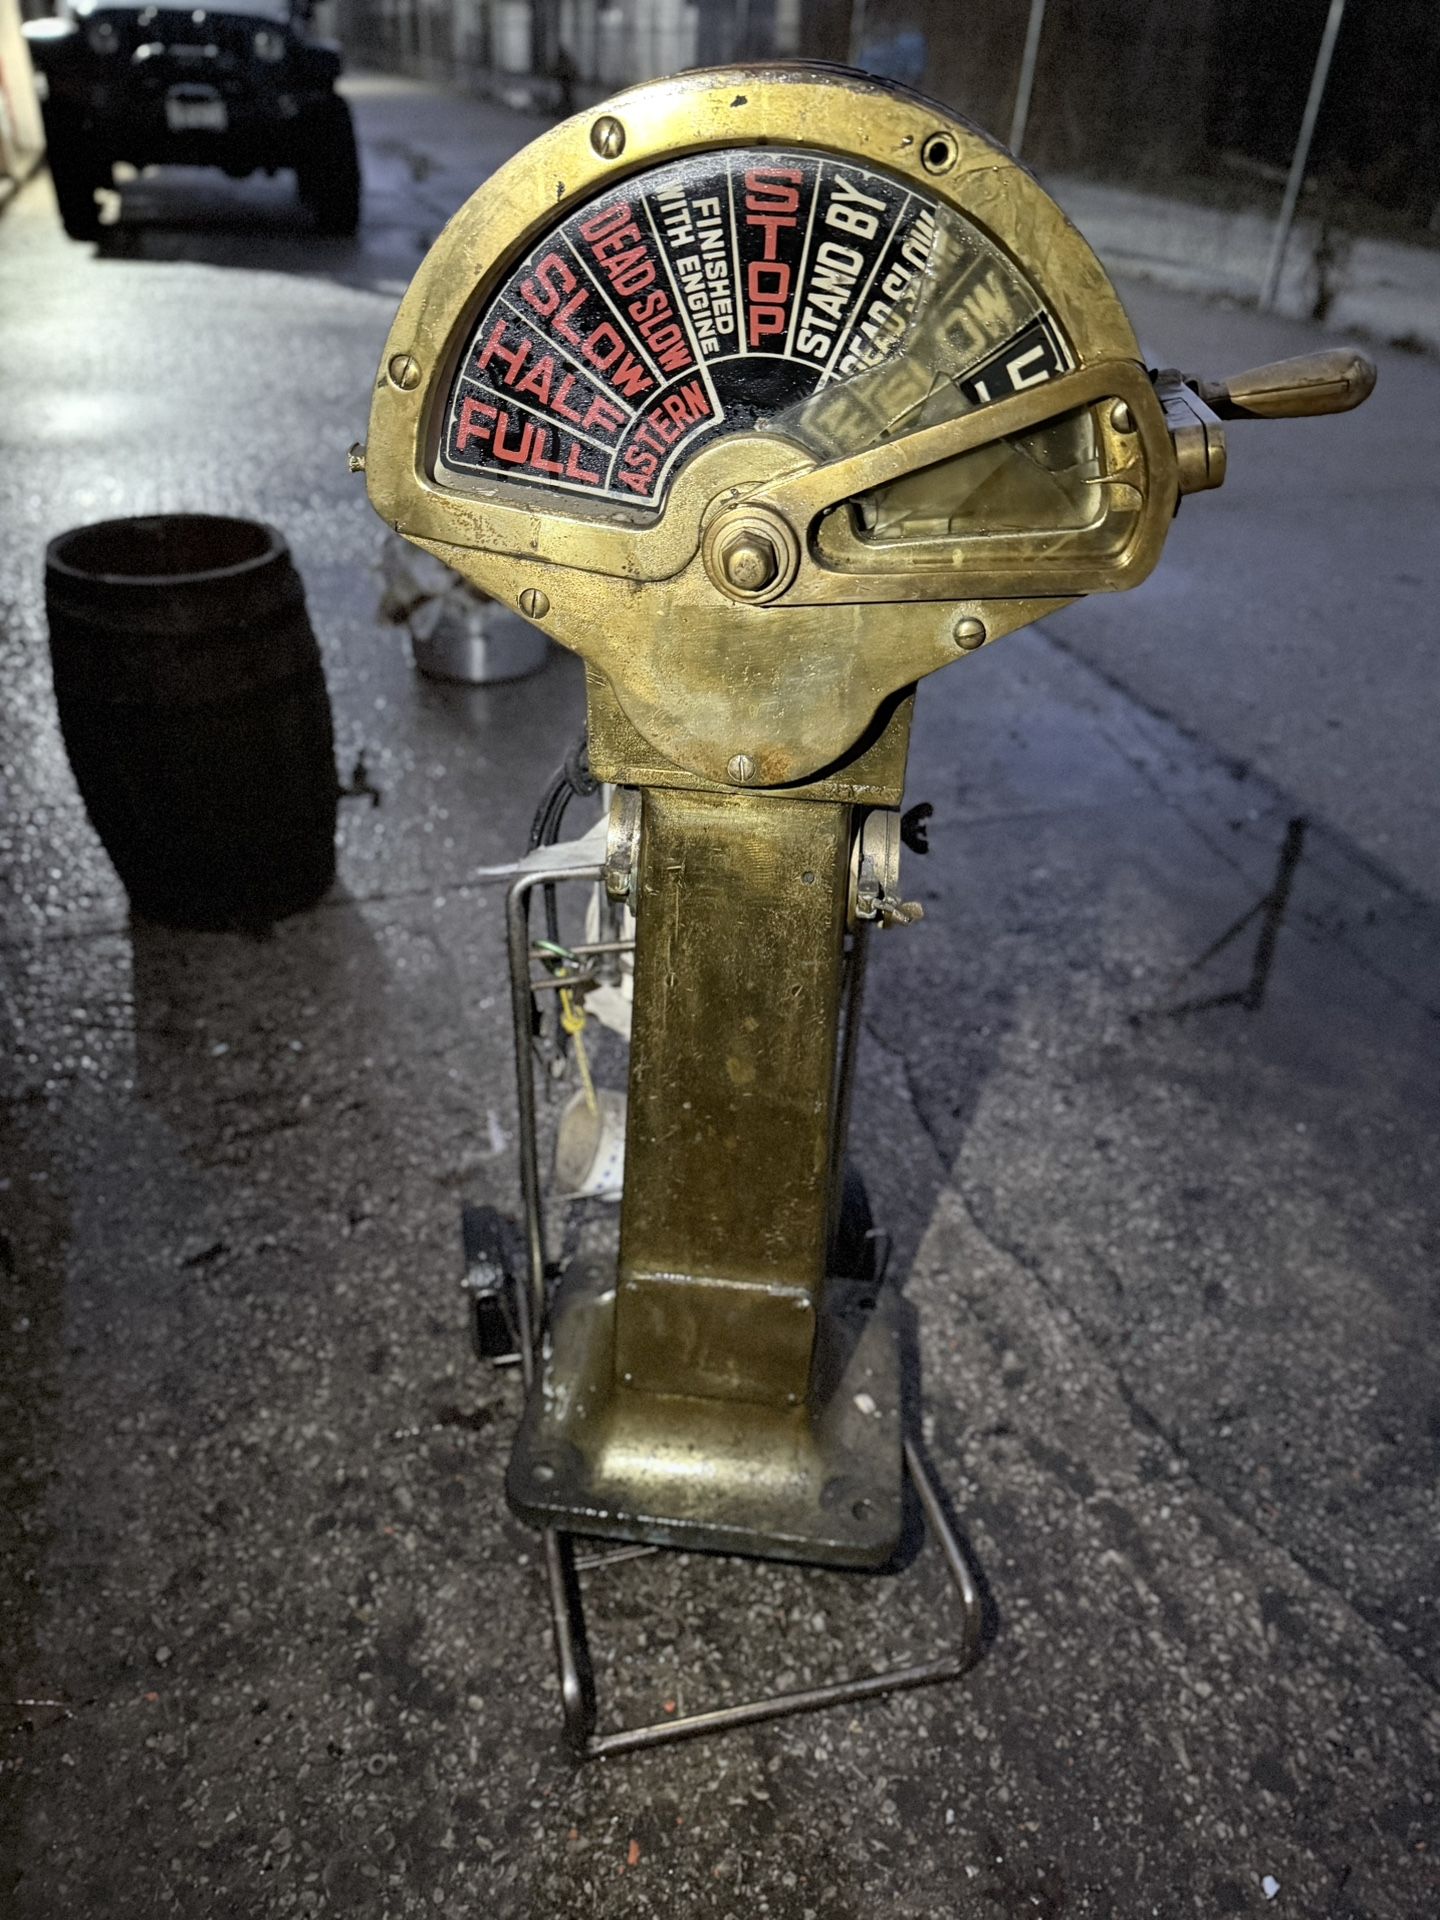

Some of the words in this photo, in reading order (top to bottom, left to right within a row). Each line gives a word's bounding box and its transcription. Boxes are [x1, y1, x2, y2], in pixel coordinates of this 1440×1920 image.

[655, 182, 695, 247] WITH
[676, 255, 720, 355] ENGINE
[692, 196, 735, 335] FINISHED
[744, 168, 803, 347] STOP
[825, 174, 888, 240] BY
[520, 252, 653, 397] SLOW
[578, 201, 656, 297] DEAD
[628, 289, 693, 372] SLOW
[796, 240, 865, 359] STAND
[455, 396, 599, 484] FULL
[477, 320, 625, 433] HALF
[618, 380, 711, 495] ASTERN
